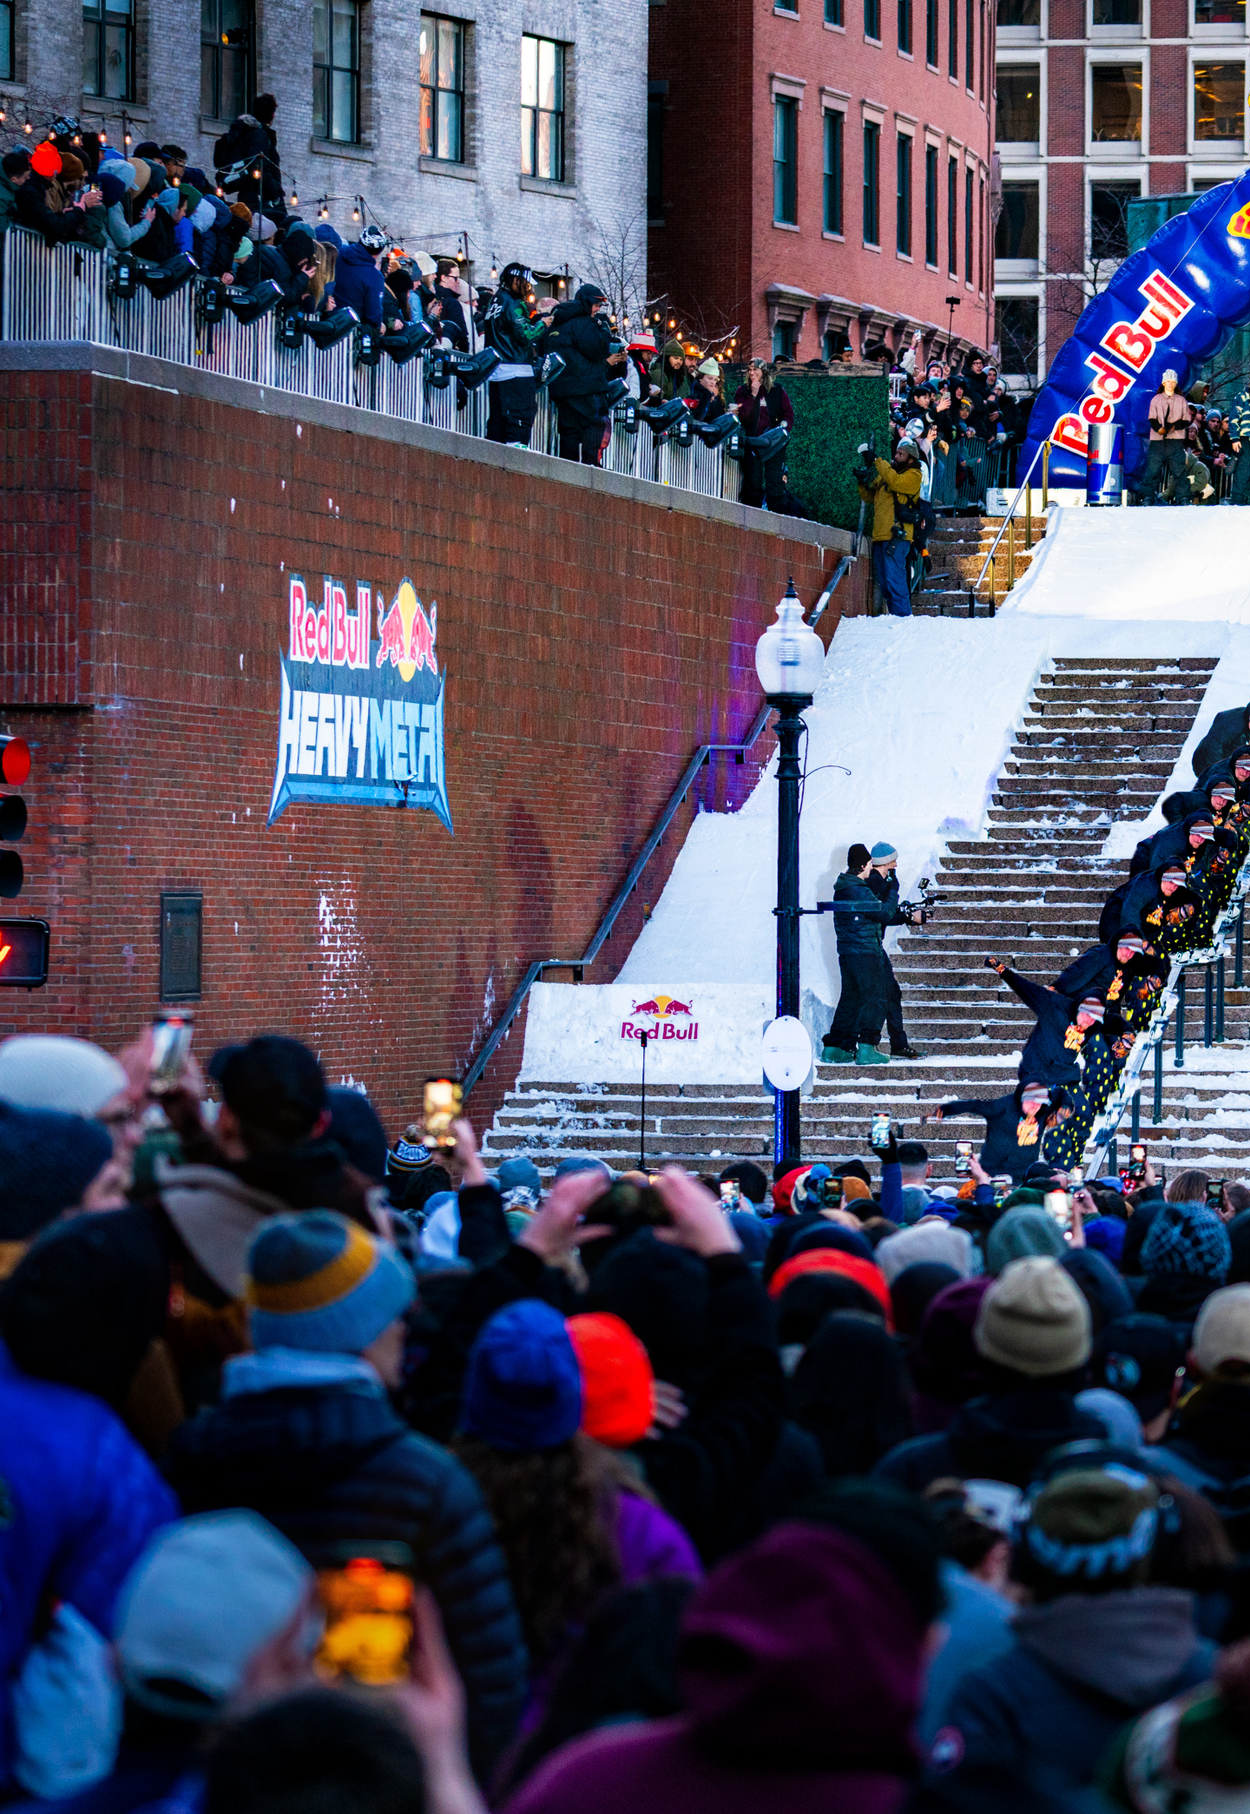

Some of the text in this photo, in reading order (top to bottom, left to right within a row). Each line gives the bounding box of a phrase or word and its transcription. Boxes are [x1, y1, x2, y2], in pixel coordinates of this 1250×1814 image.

[1050, 269, 1195, 457] Red Bull
[289, 580, 371, 669] Red Bull
[269, 664, 370, 808] HEAVY
[620, 1022, 698, 1040] Red Bull
